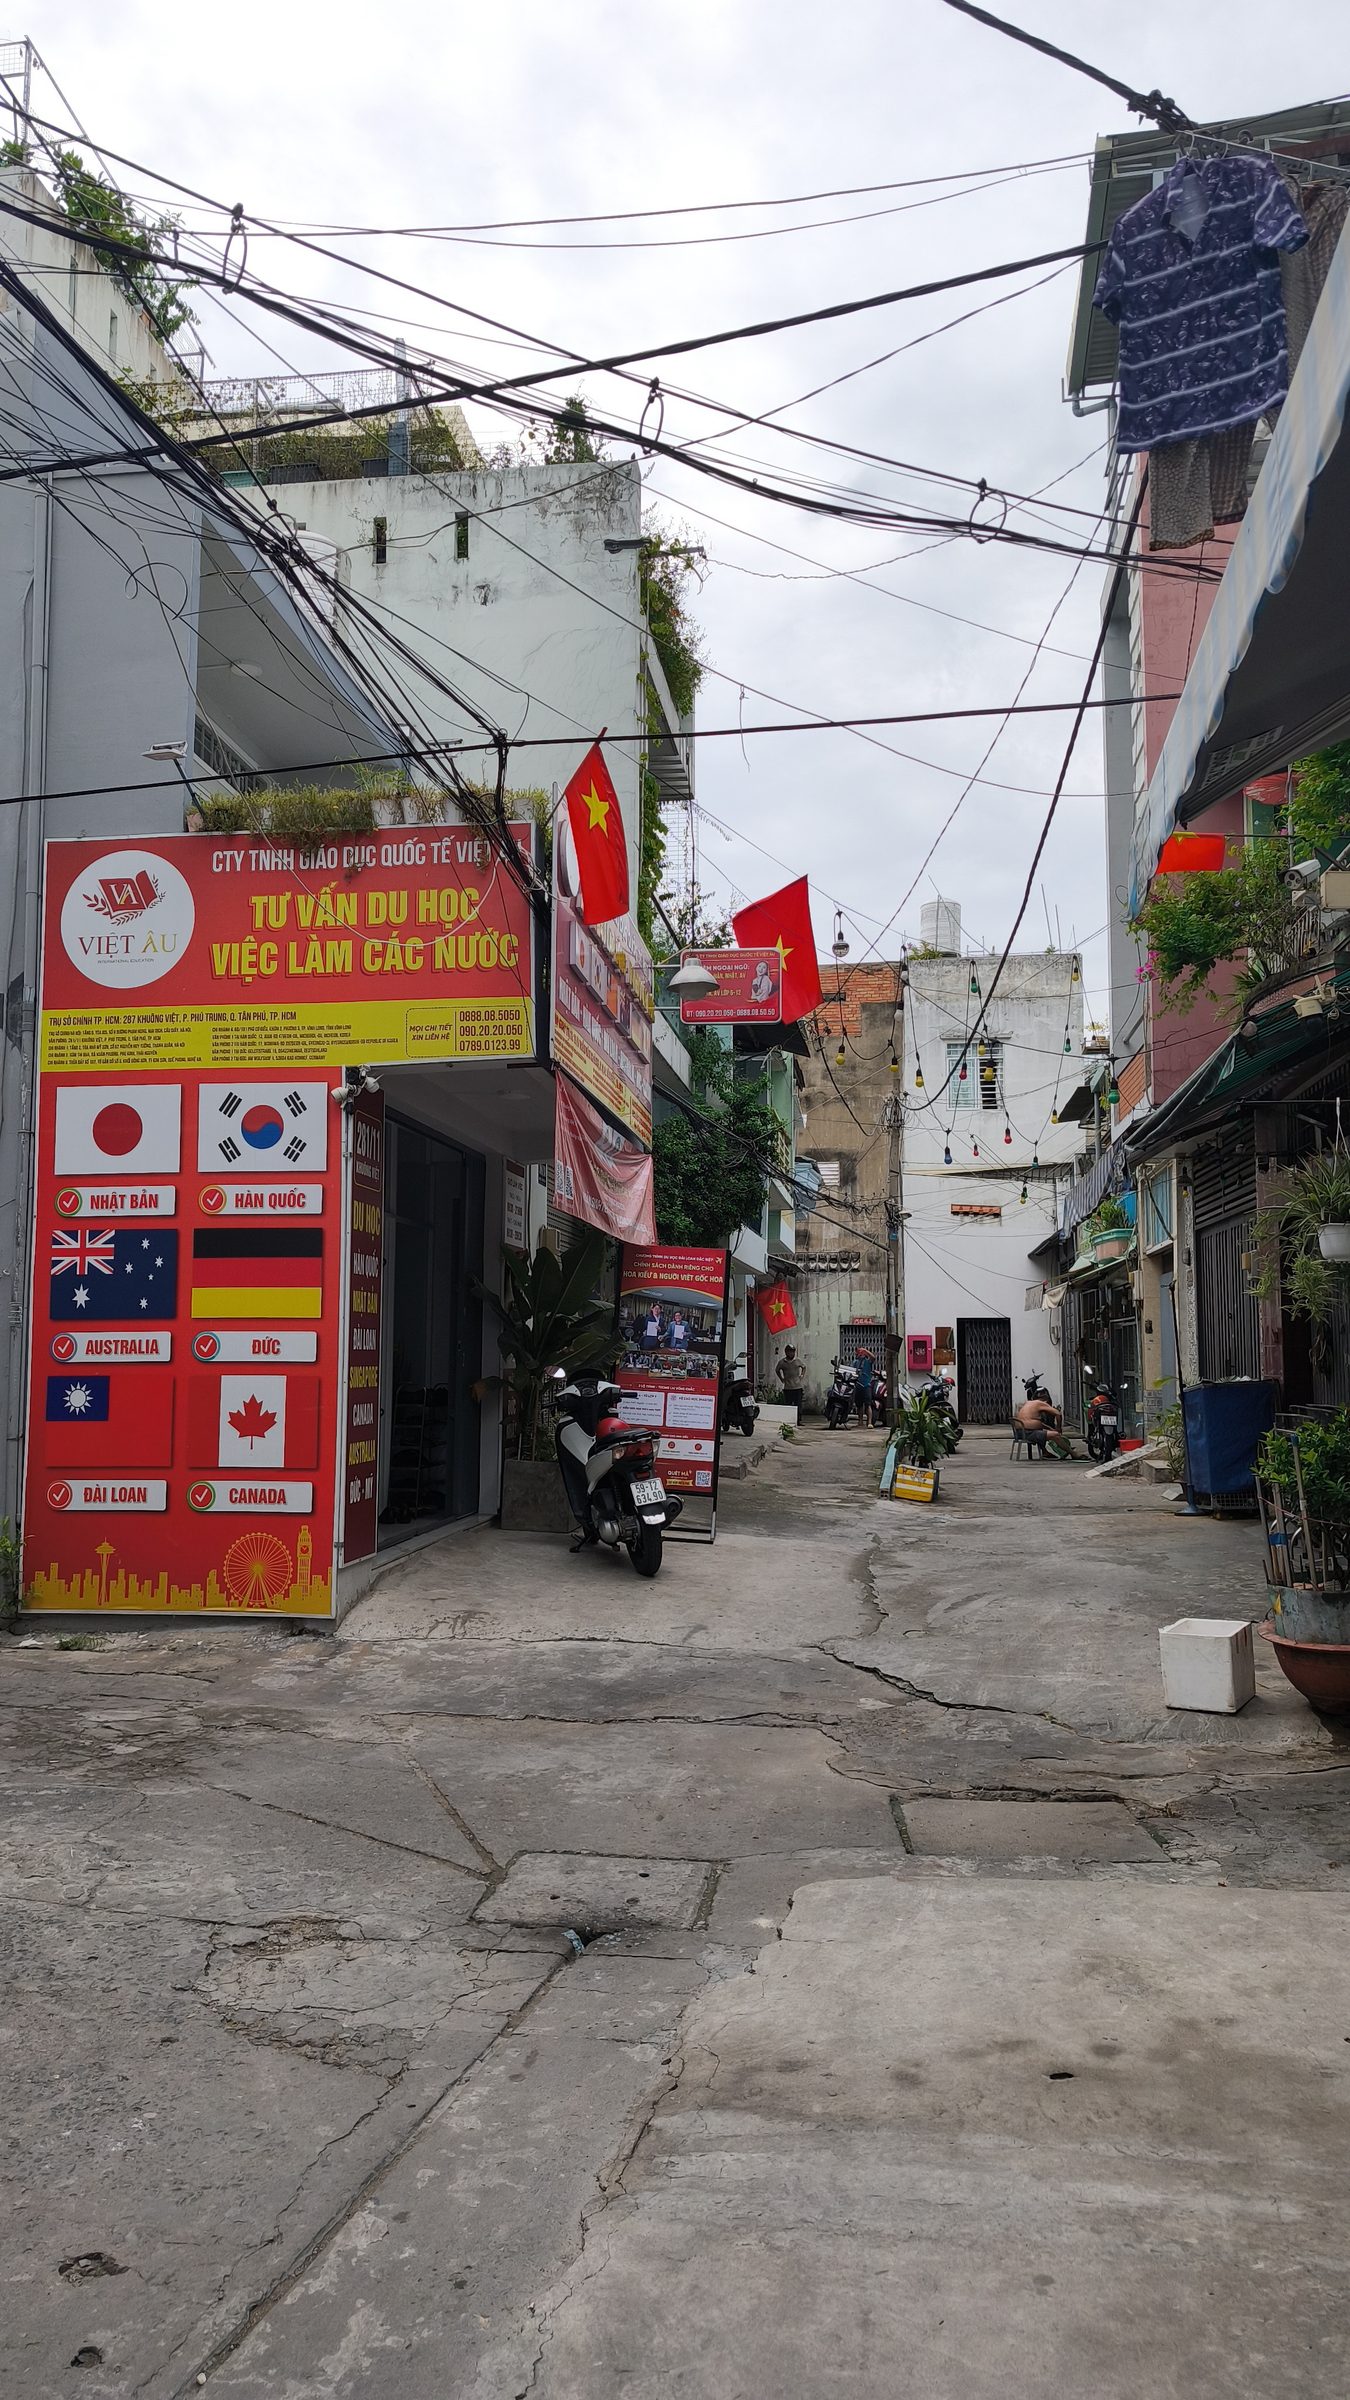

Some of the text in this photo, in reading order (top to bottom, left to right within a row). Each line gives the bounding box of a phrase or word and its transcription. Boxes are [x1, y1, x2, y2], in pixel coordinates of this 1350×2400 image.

[212, 850, 245, 873] CTY
[248, 849, 295, 871] TNHH
[299, 844, 338, 870] GIÁO
[342, 845, 377, 872] DỤC
[381, 836, 426, 868] QUỐC
[430, 835, 455, 864] TẾ
[250, 881, 480, 930] TƯ VẤN DU HỌC
[78, 930, 178, 958] VIỆT ÂU
[211, 928, 519, 983] VIỆC LÀM CÁC NƯỚC
[49, 1017, 61, 1027] TRỤ
[62, 1015, 72, 1025] SỞ
[72, 1015, 92, 1025] CHÍNH
[105, 1016, 122, 1025] HCM:
[123, 1015, 135, 1024] 287
[137, 1013, 164, 1023] KHUÔNG
[164, 1012, 181, 1024] VIỆT,
[182, 1013, 189, 1022] P.
[191, 1012, 204, 1022] PHÚ
[205, 1012, 229, 1022] TRUNG,
[230, 1013, 237, 1021] Q.
[238, 1011, 252, 1021] TÂN
[252, 1010, 268, 1021] PHÚ,
[269, 1011, 279, 1020] TP.
[281, 1011, 297, 1020] HCM
[409, 1022, 453, 1033] MỌI CHI TIẾT
[459, 1009, 521, 1022] 0888.08.5050
[412, 1032, 451, 1042] XIN LIÊN HỆ
[459, 1024, 523, 1037] 090.20.20.050
[459, 1039, 521, 1052] 0789.0123.99
[356, 1120, 381, 1163] 281/11
[89, 1188, 160, 1213] NHẬT BẢN
[234, 1187, 307, 1209] HÀN QUỐC
[353, 1200, 381, 1241] DU HỌC
[353, 1248, 379, 1279] HÀN QUỐC
[709, 1275, 724, 1284] HOA
[352, 1285, 379, 1318] NHẬT BẢN
[84, 1338, 160, 1357] AUSTRALIA
[251, 1336, 282, 1357] ĐỨC
[352, 1323, 377, 1351] ĐÀI LOAN
[349, 1365, 378, 1389] SINGAPORE
[352, 1403, 374, 1427] CANADA
[348, 1439, 377, 1466] AUSTRALIA
[83, 1486, 148, 1505] ĐÀI LOAN
[228, 1487, 287, 1505] CANADA
[350, 1474, 362, 1505] ĐỨC
[635, 1480, 659, 1494] 59-T2
